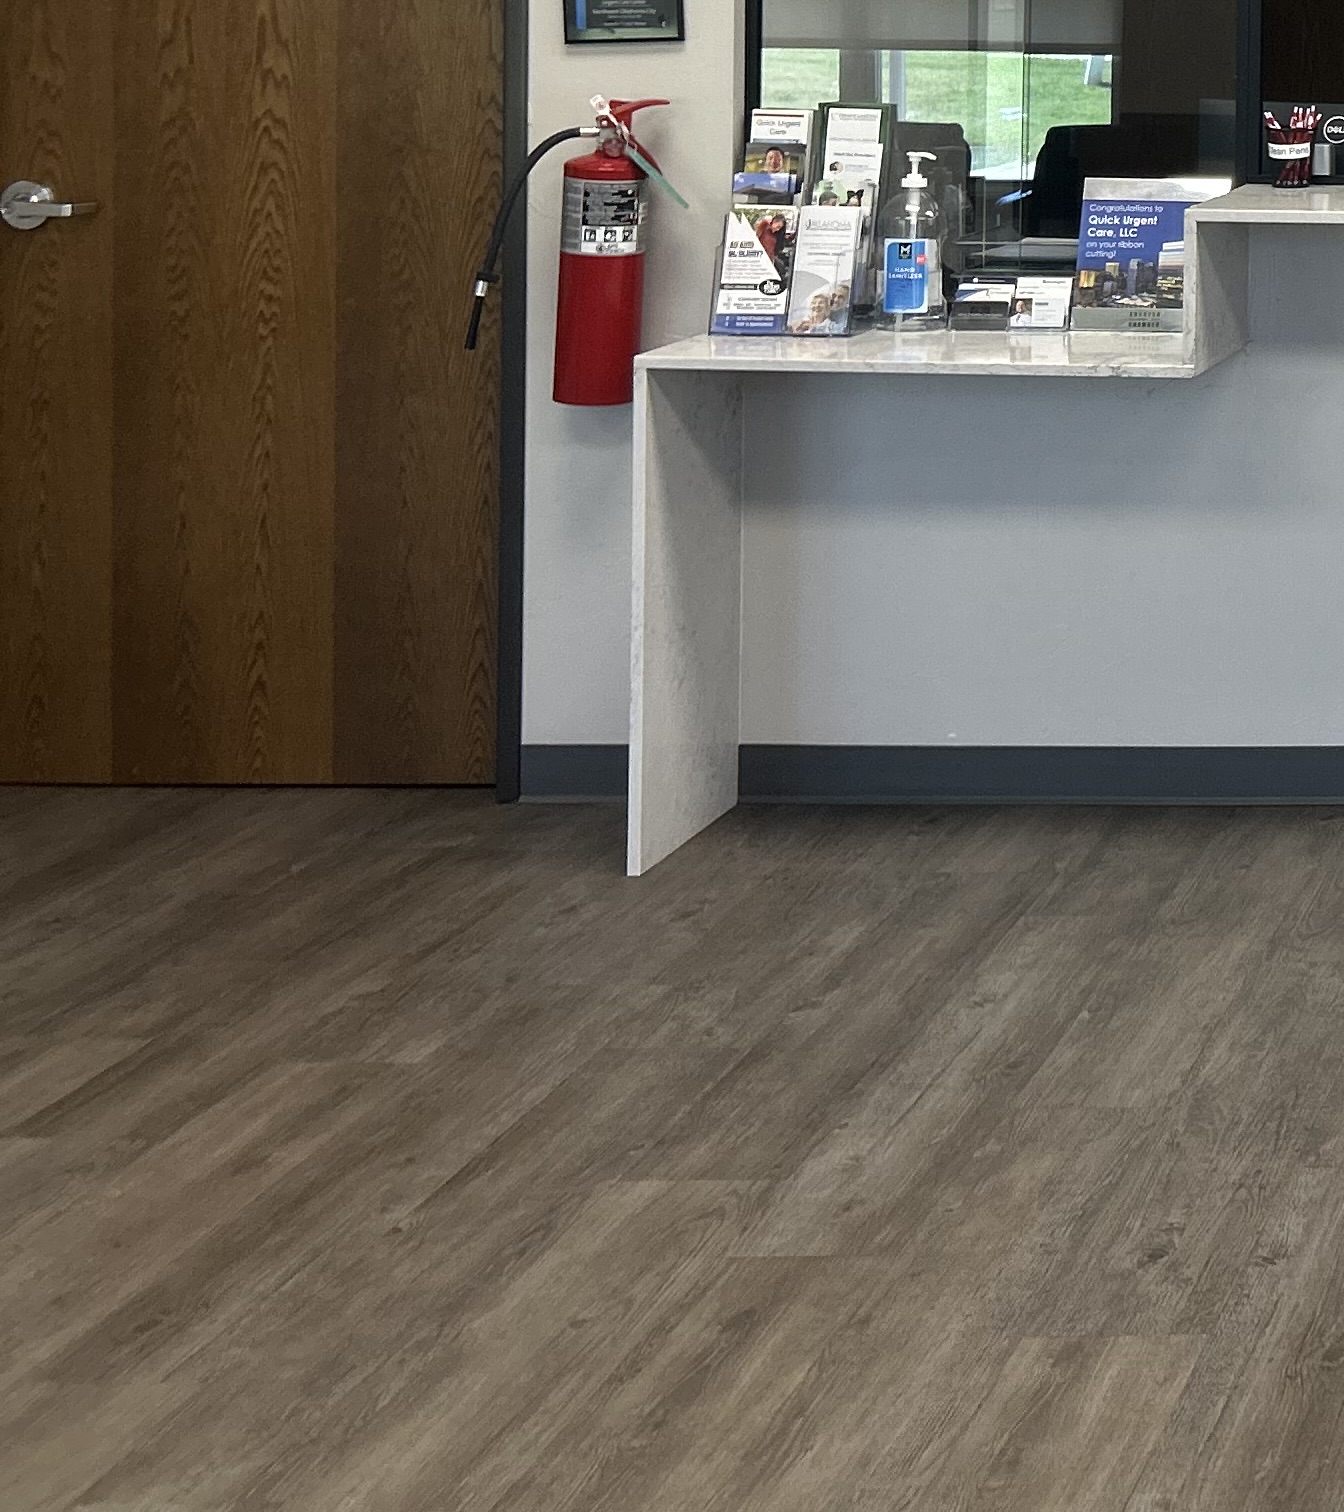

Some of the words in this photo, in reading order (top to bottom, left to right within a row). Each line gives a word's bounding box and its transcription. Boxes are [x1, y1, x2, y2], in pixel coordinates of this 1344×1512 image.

[1089, 204, 1153, 213] Congratulations
[1088, 215, 1120, 225] Quick
[1123, 215, 1158, 226] Urgent
[1087, 228, 1117, 238] Care,
[1119, 228, 1138, 237] LLC
